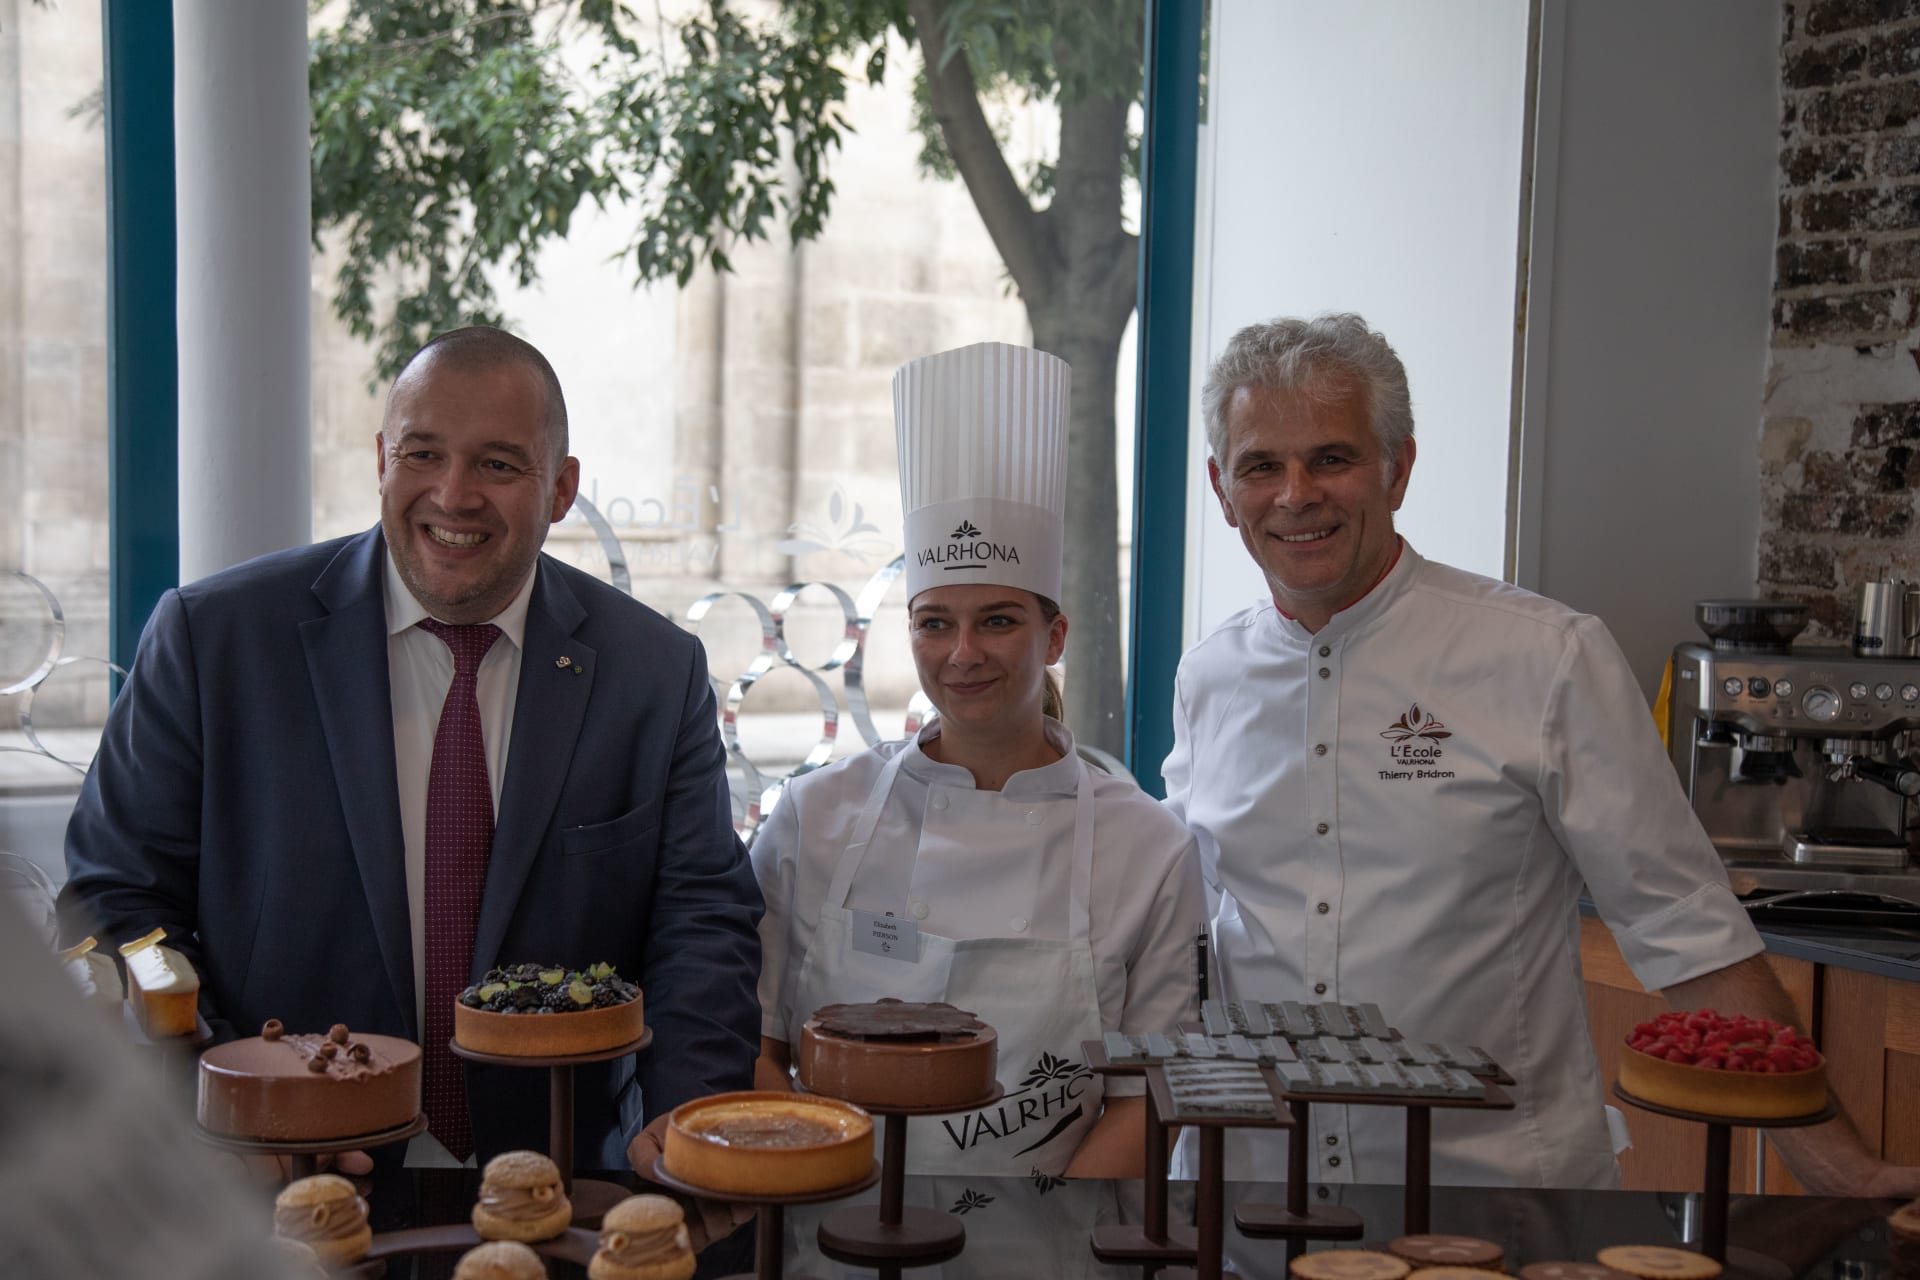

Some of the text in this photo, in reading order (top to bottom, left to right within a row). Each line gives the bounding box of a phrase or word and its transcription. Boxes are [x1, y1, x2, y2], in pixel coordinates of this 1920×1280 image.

[917, 541, 1020, 567] VALRHONA
[1379, 769, 1455, 781] Thierry Bridron
